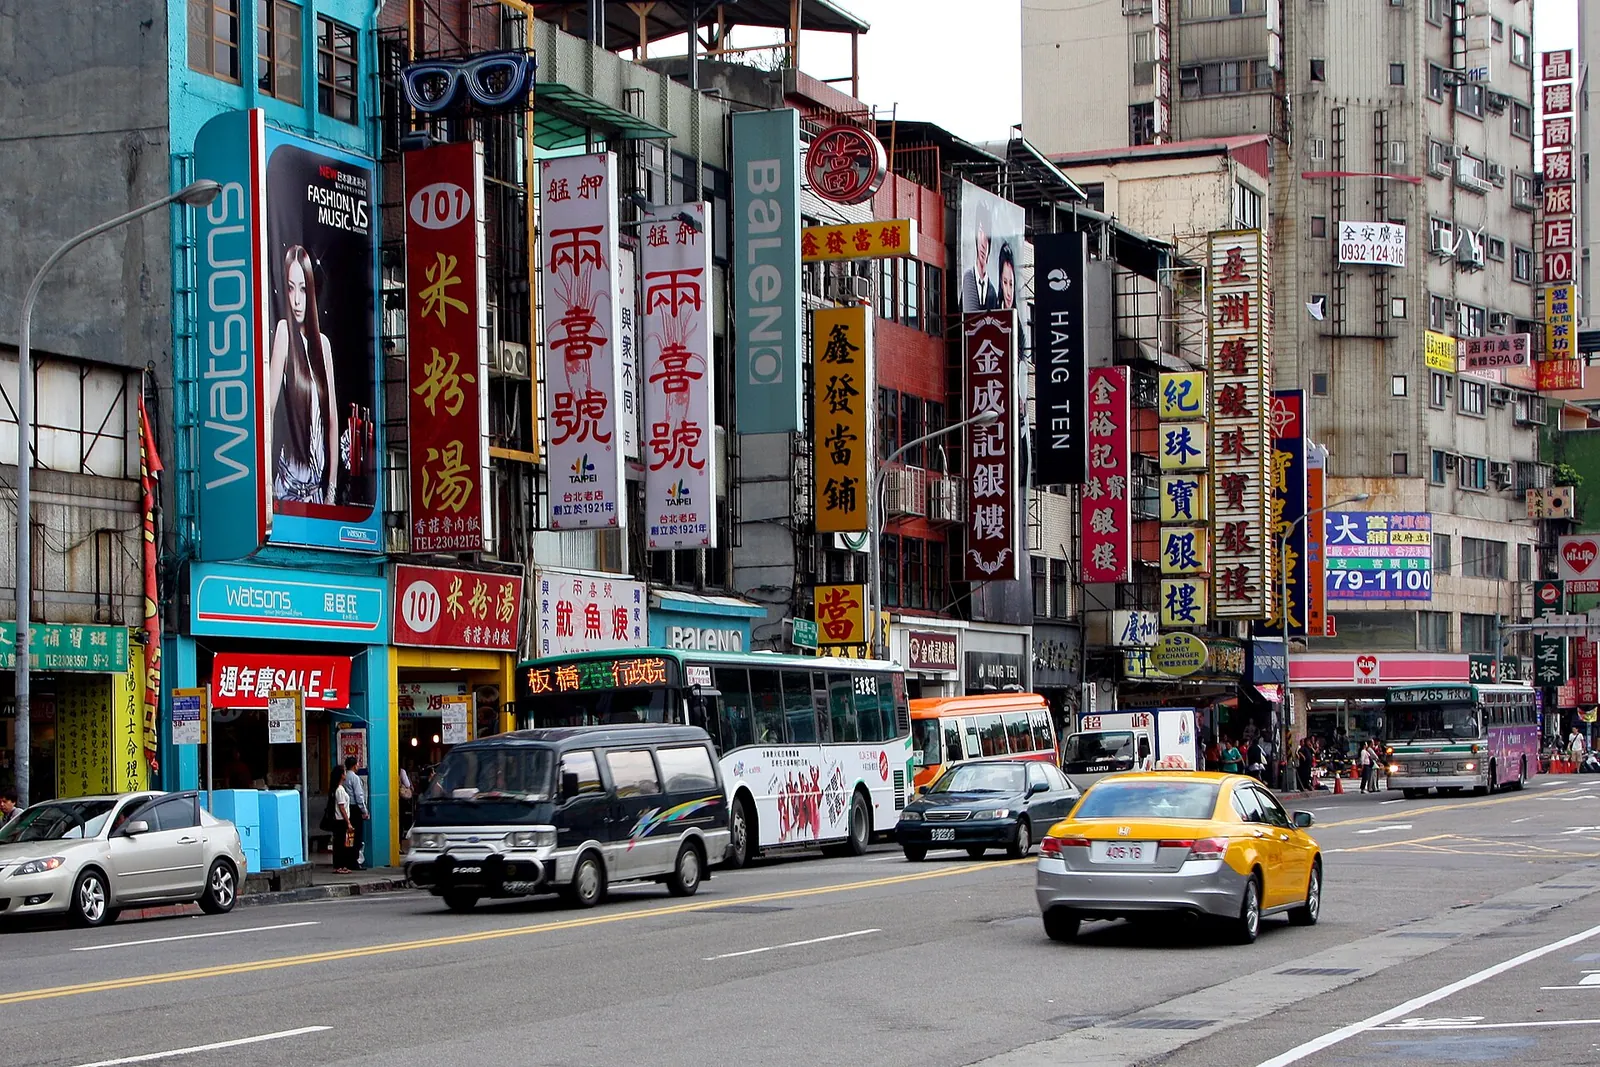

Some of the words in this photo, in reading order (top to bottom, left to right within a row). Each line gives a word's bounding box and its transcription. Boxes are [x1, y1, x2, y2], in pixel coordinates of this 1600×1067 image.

[1468, 67, 1488, 82] 11F
[547, 174, 604, 203] 艋舺
[420, 188, 464, 223] 101
[1341, 223, 1405, 245] 全安廣告
[1340, 243, 1405, 265] 0932-124-316
[549, 225, 612, 445] 兩喜號
[1051, 310, 1070, 384] HANG
[412, 251, 476, 514] 米粉湯
[645, 267, 707, 471] 兩喜號
[1051, 400, 1070, 450] TEN
[972, 339, 1006, 541] 金成記銀樓
[569, 474, 598, 484] TAIPEI
[563, 490, 604, 503] 台北老店
[665, 499, 692, 507] TAIPEI
[659, 513, 697, 524] 台北老店
[414, 534, 481, 551] TEL:23042175
[409, 589, 438, 623] 101
[446, 574, 516, 624] 米粉湯
[817, 587, 860, 641] 當
[1156, 651, 1200, 660] EXCHANGER
[612, 657, 667, 687] 行政院
[1420, 690, 1444, 701] 265
